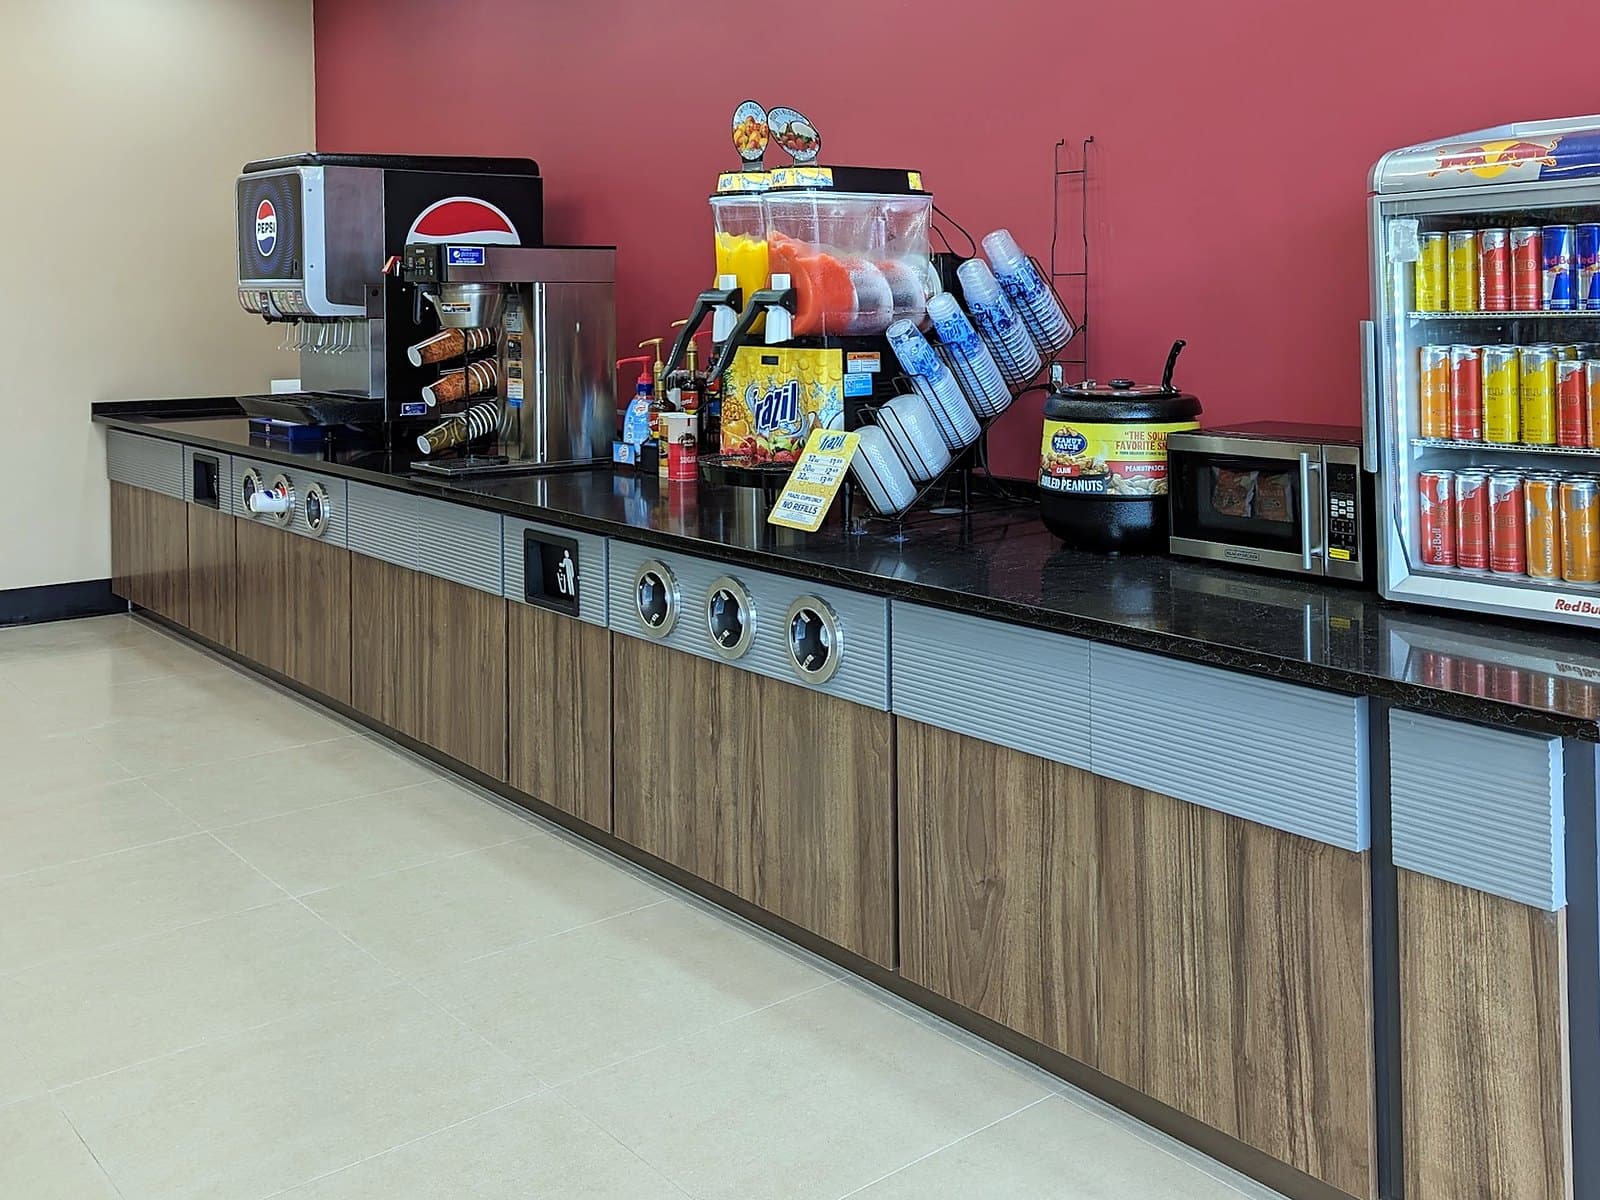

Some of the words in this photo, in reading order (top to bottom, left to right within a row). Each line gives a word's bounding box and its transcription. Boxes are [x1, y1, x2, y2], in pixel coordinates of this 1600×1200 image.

[257, 221, 276, 234] PEPSI
[1054, 436, 1082, 445] PEANUT
[1056, 443, 1079, 451] PATCH
[1115, 441, 1156, 451] FAVORITE
[1061, 477, 1103, 492] PEANUTS
[782, 500, 793, 510] NO
[793, 502, 818, 515] REFILLS
[1432, 528, 1442, 545] Bull
[1432, 545, 1442, 562] Red
[1555, 598, 1582, 612] Red
